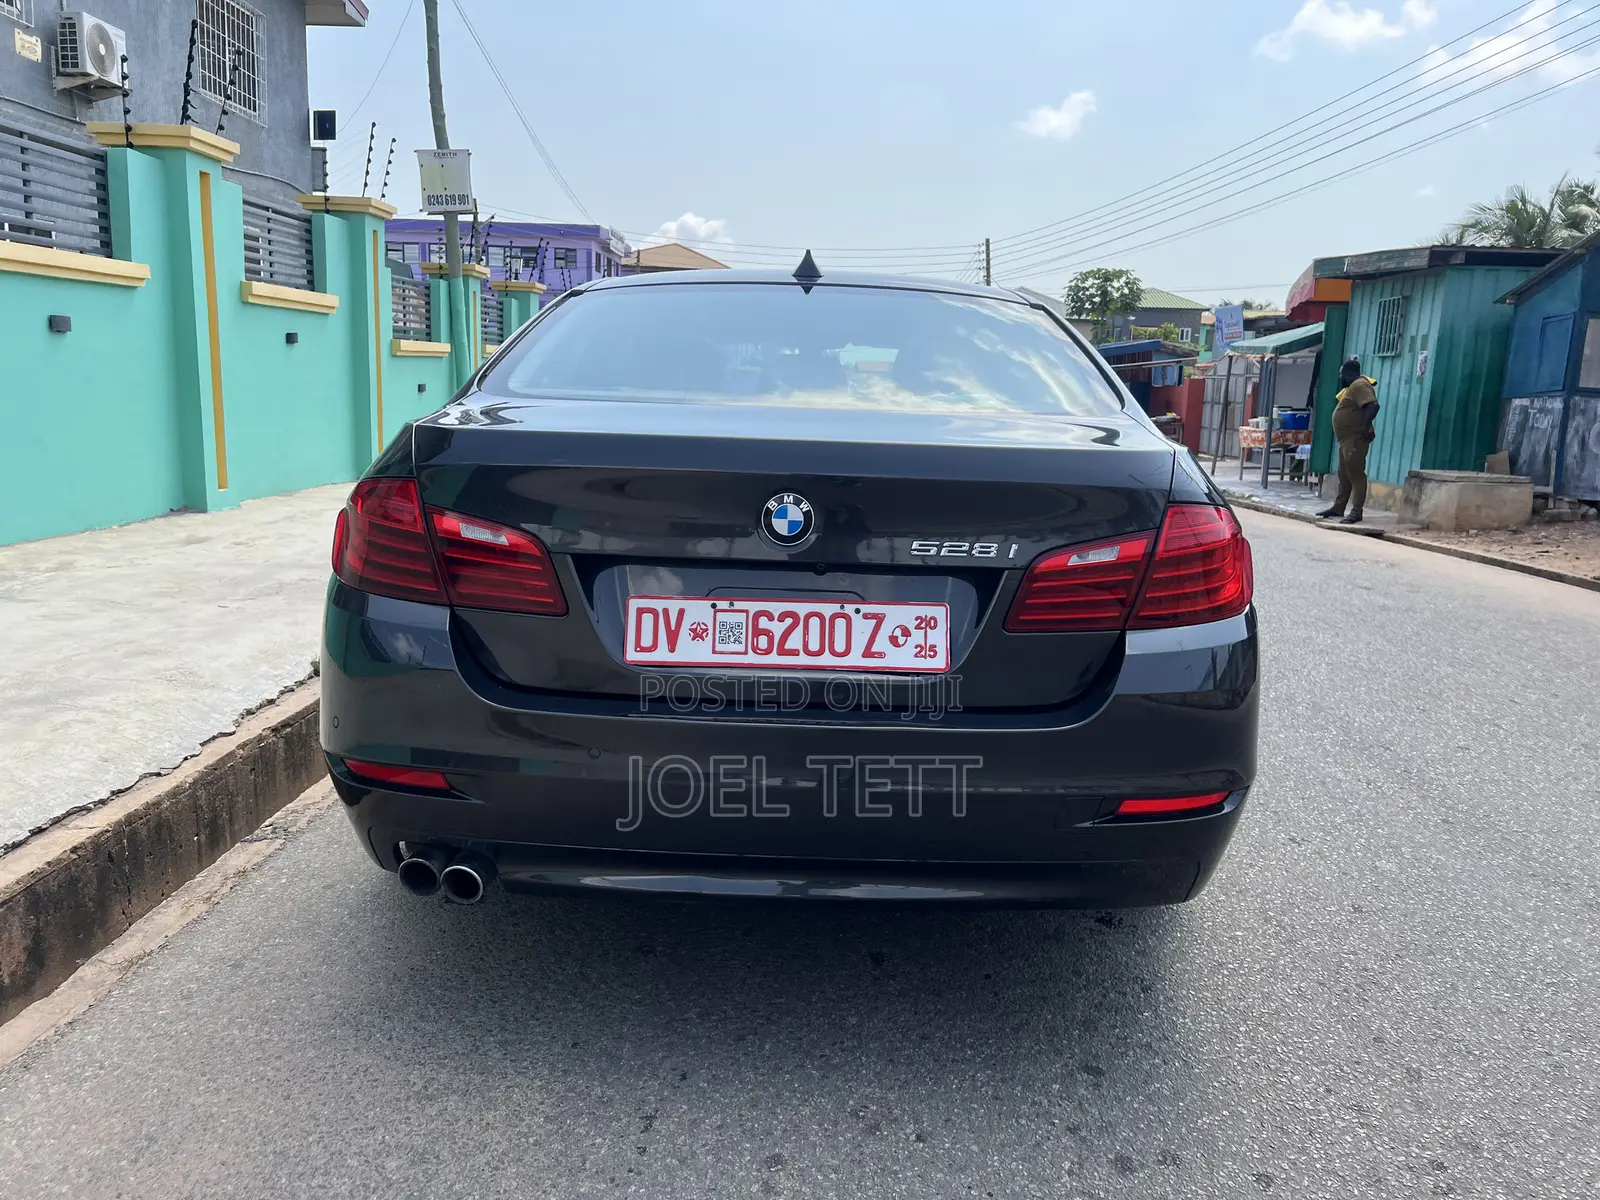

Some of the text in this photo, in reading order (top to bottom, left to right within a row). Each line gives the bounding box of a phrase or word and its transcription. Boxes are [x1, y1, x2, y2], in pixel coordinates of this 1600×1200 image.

[427, 194, 470, 206] 0243 619 901
[767, 494, 810, 512] BMW
[634, 607, 887, 659] DV 6200 Z
